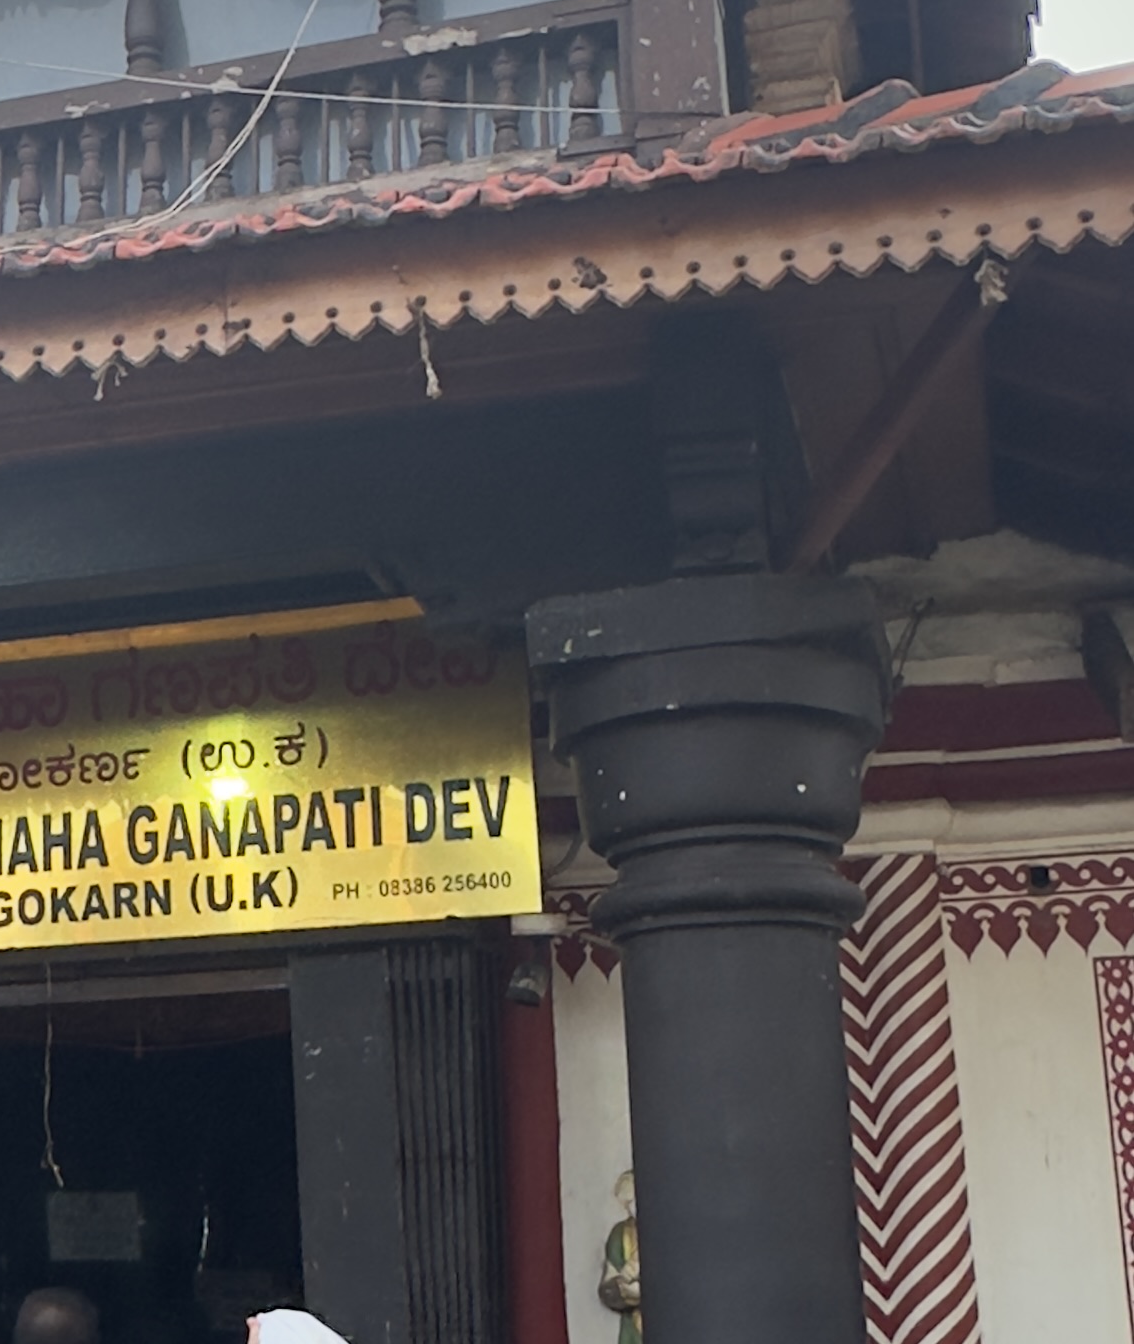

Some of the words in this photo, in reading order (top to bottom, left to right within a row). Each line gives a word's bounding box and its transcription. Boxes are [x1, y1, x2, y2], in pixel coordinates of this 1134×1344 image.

[91, 633, 317, 722] ಗಣಪತಿ
[180, 722, 329, 779] (ಉ.ಕ)
[127, 785, 383, 866] GANAPATI
[404, 774, 511, 845] DEV
[190, 866, 299, 915] (U.K)
[379, 876, 437, 897] 08386
[442, 860, 512, 893] 256400
